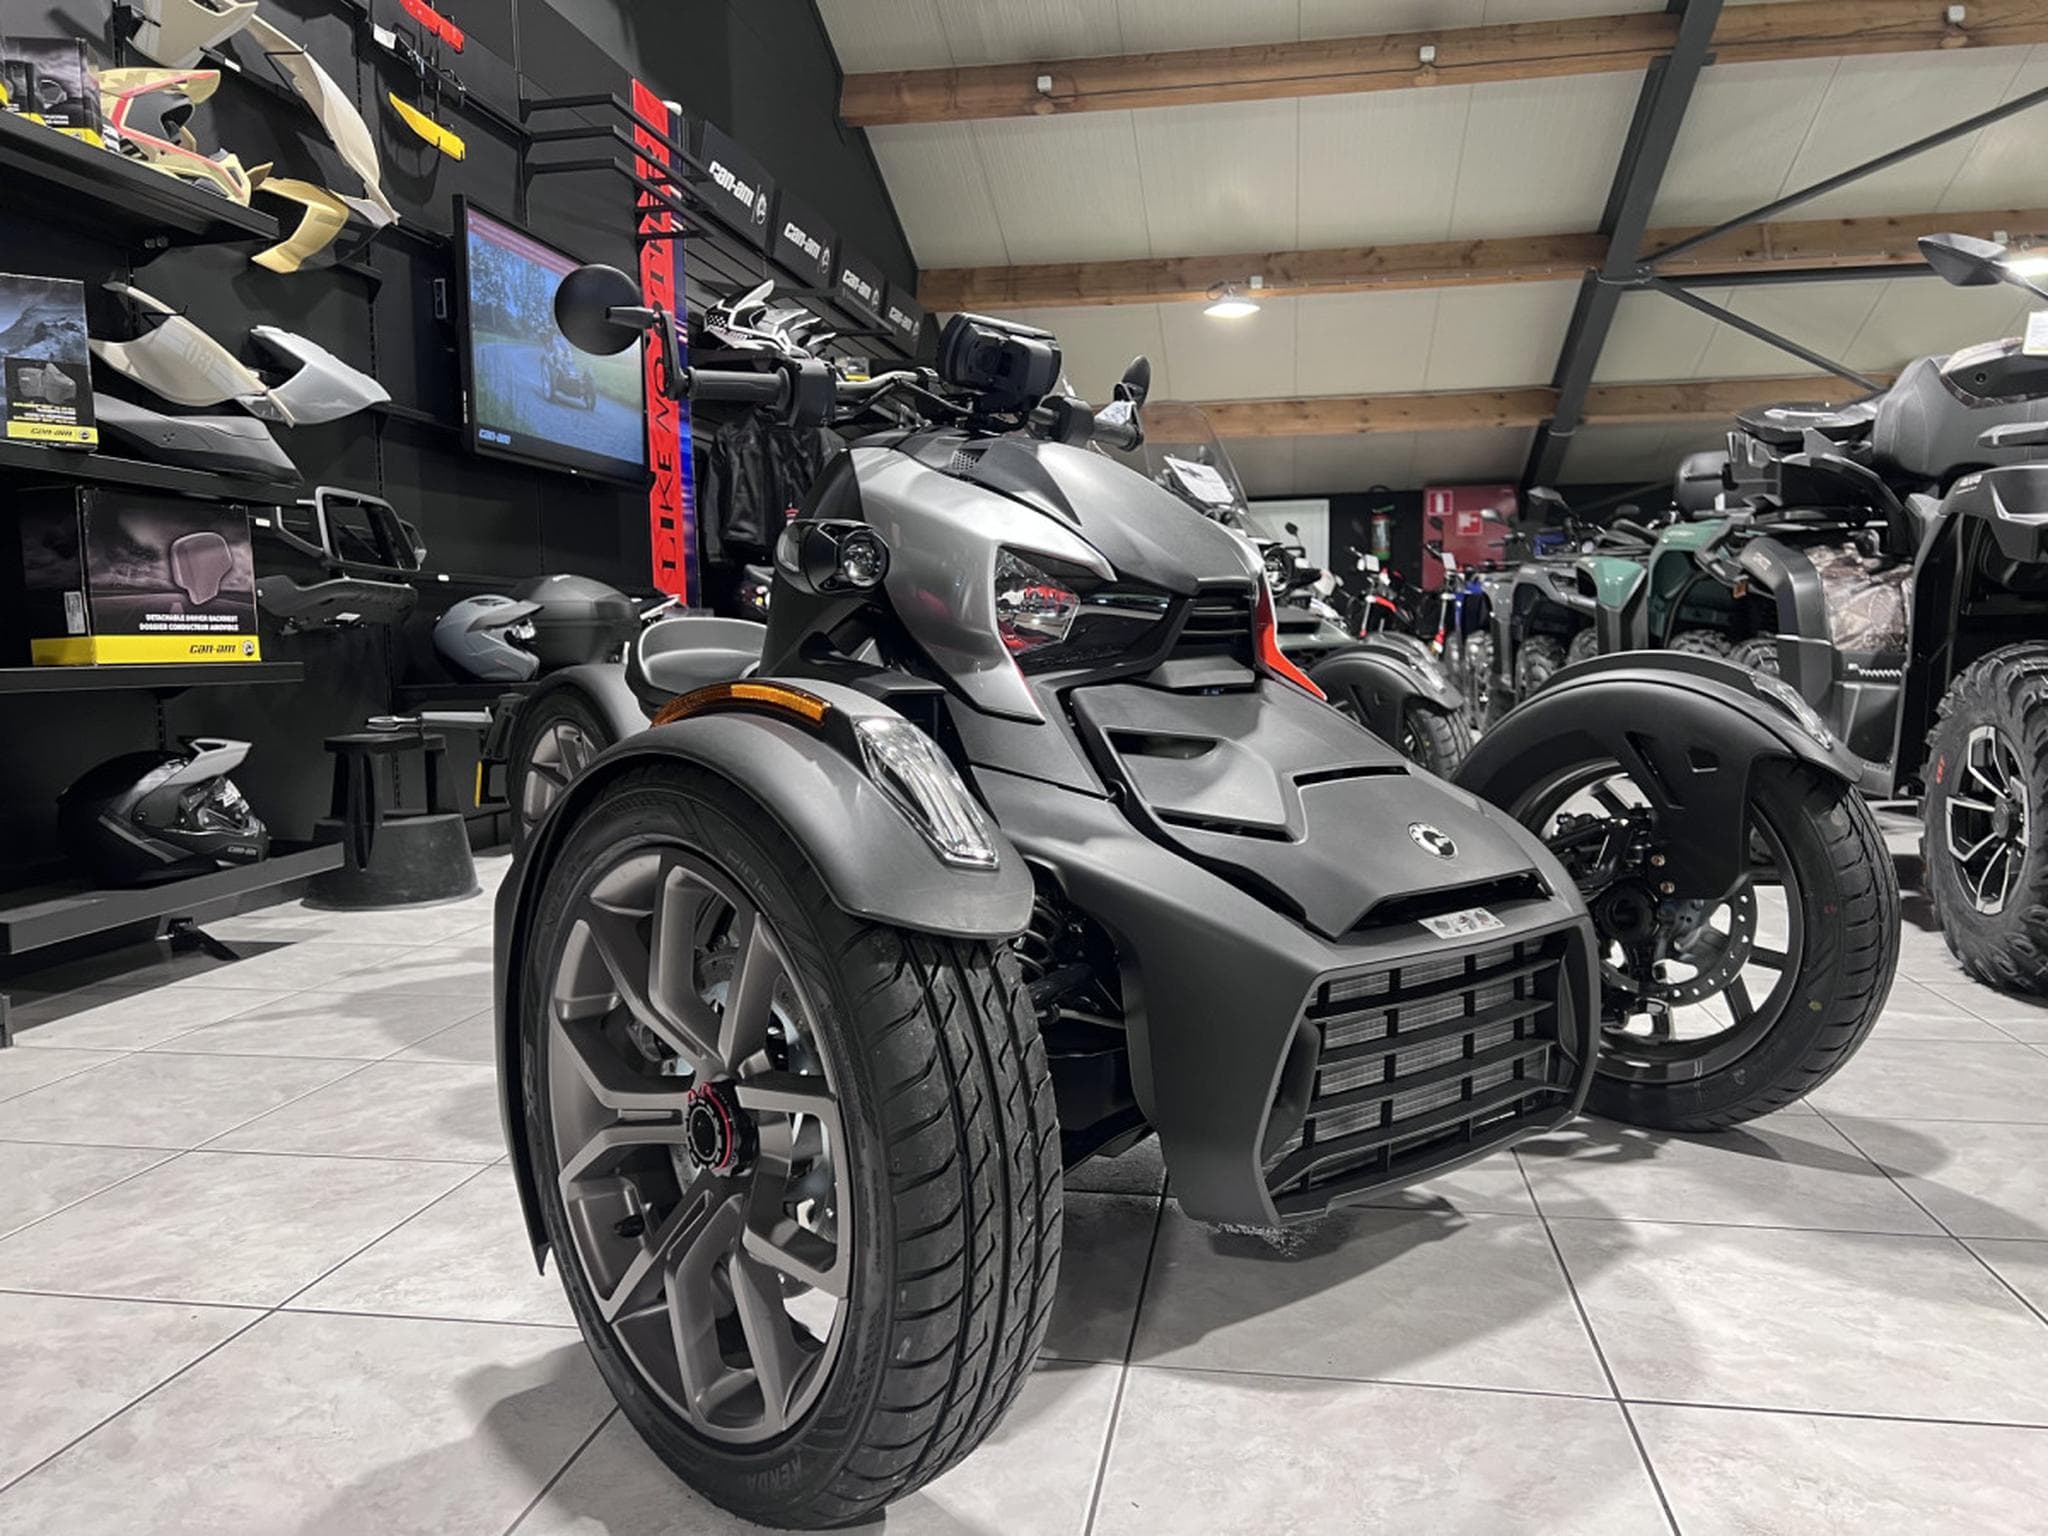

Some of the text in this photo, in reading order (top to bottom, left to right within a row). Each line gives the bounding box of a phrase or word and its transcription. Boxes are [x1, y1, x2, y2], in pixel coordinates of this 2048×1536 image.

[709, 160, 755, 208] can-am
[784, 222, 821, 260] can-am
[657, 452, 677, 570] LIKE
[189, 644, 237, 655] can-am
